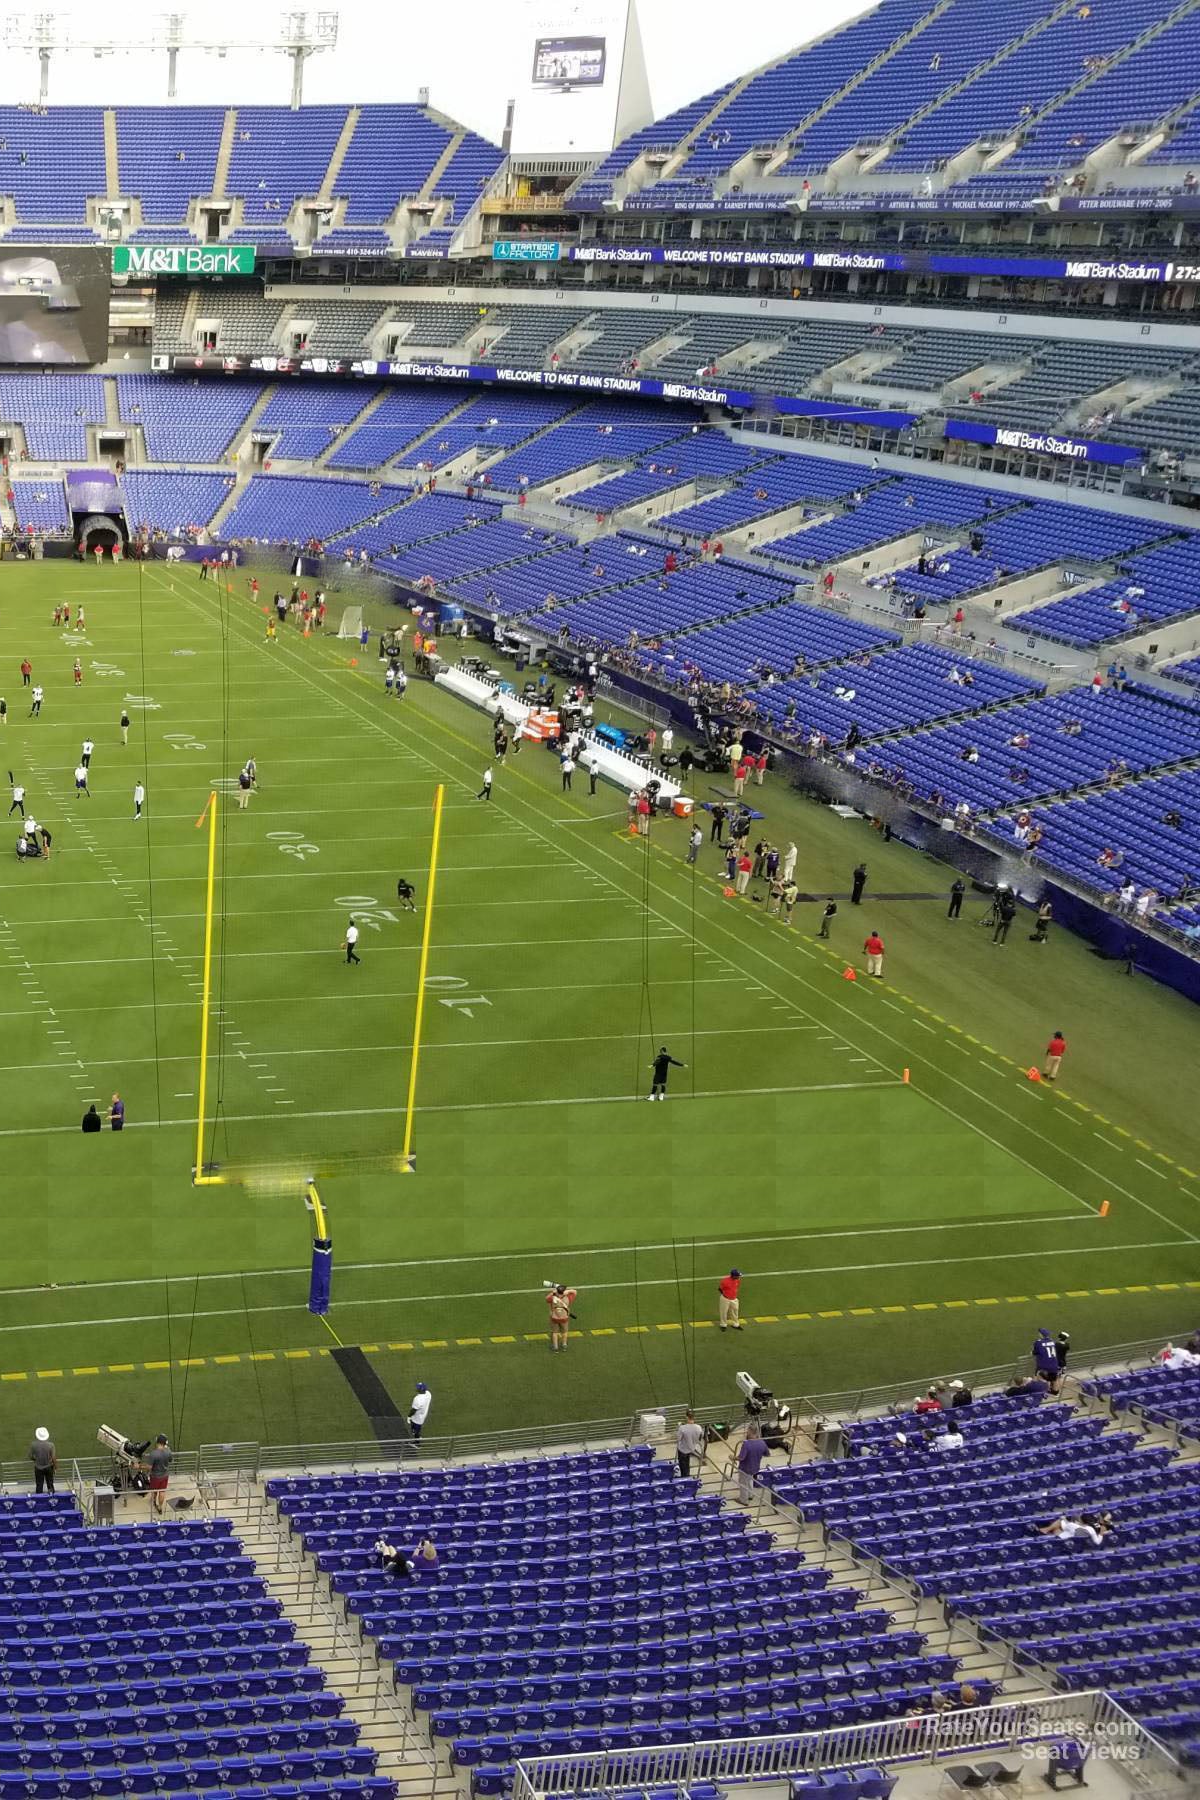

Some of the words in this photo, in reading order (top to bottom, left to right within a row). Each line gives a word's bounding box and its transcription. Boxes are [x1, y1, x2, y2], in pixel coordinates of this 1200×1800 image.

[127, 247, 186, 272] M&T
[186, 248, 241, 272] Bank
[509, 250, 555, 259] FACTORY
[574, 247, 596, 260] M&T
[596, 248, 617, 260] Bank
[616, 248, 652, 261] Stadium
[664, 250, 707, 261] WELCOME
[709, 251, 722, 262] TO
[723, 251, 743, 262] M&T
[744, 252, 768, 263] BANK
[769, 253, 805, 265] STADIUM
[813, 253, 835, 267] M&T
[833, 254, 852, 268] Bank
[853, 255, 884, 269] Stadium
[1065, 262, 1093, 277] M&T
[1091, 263, 1118, 279] Bank
[1117, 263, 1160, 279] Stadium
[389, 362, 412, 375] M&T
[412, 363, 435, 376] Bank
[434, 365, 469, 378] Stadium
[496, 369, 542, 383] WELCOME
[543, 372, 557, 383] TO
[558, 374, 578, 386] M&T
[579, 376, 602, 388] BANK
[603, 378, 641, 392] STADIUM
[663, 383, 682, 397] M&T
[680, 386, 699, 400] Bank
[698, 388, 727, 403] Stadium
[995, 429, 1022, 447] M&T
[1020, 433, 1046, 451] Bank
[1045, 437, 1087, 458] Stadium
[266, 831, 320, 854] 30
[334, 895, 399, 923] 20
[423, 975, 493, 1008] 10
